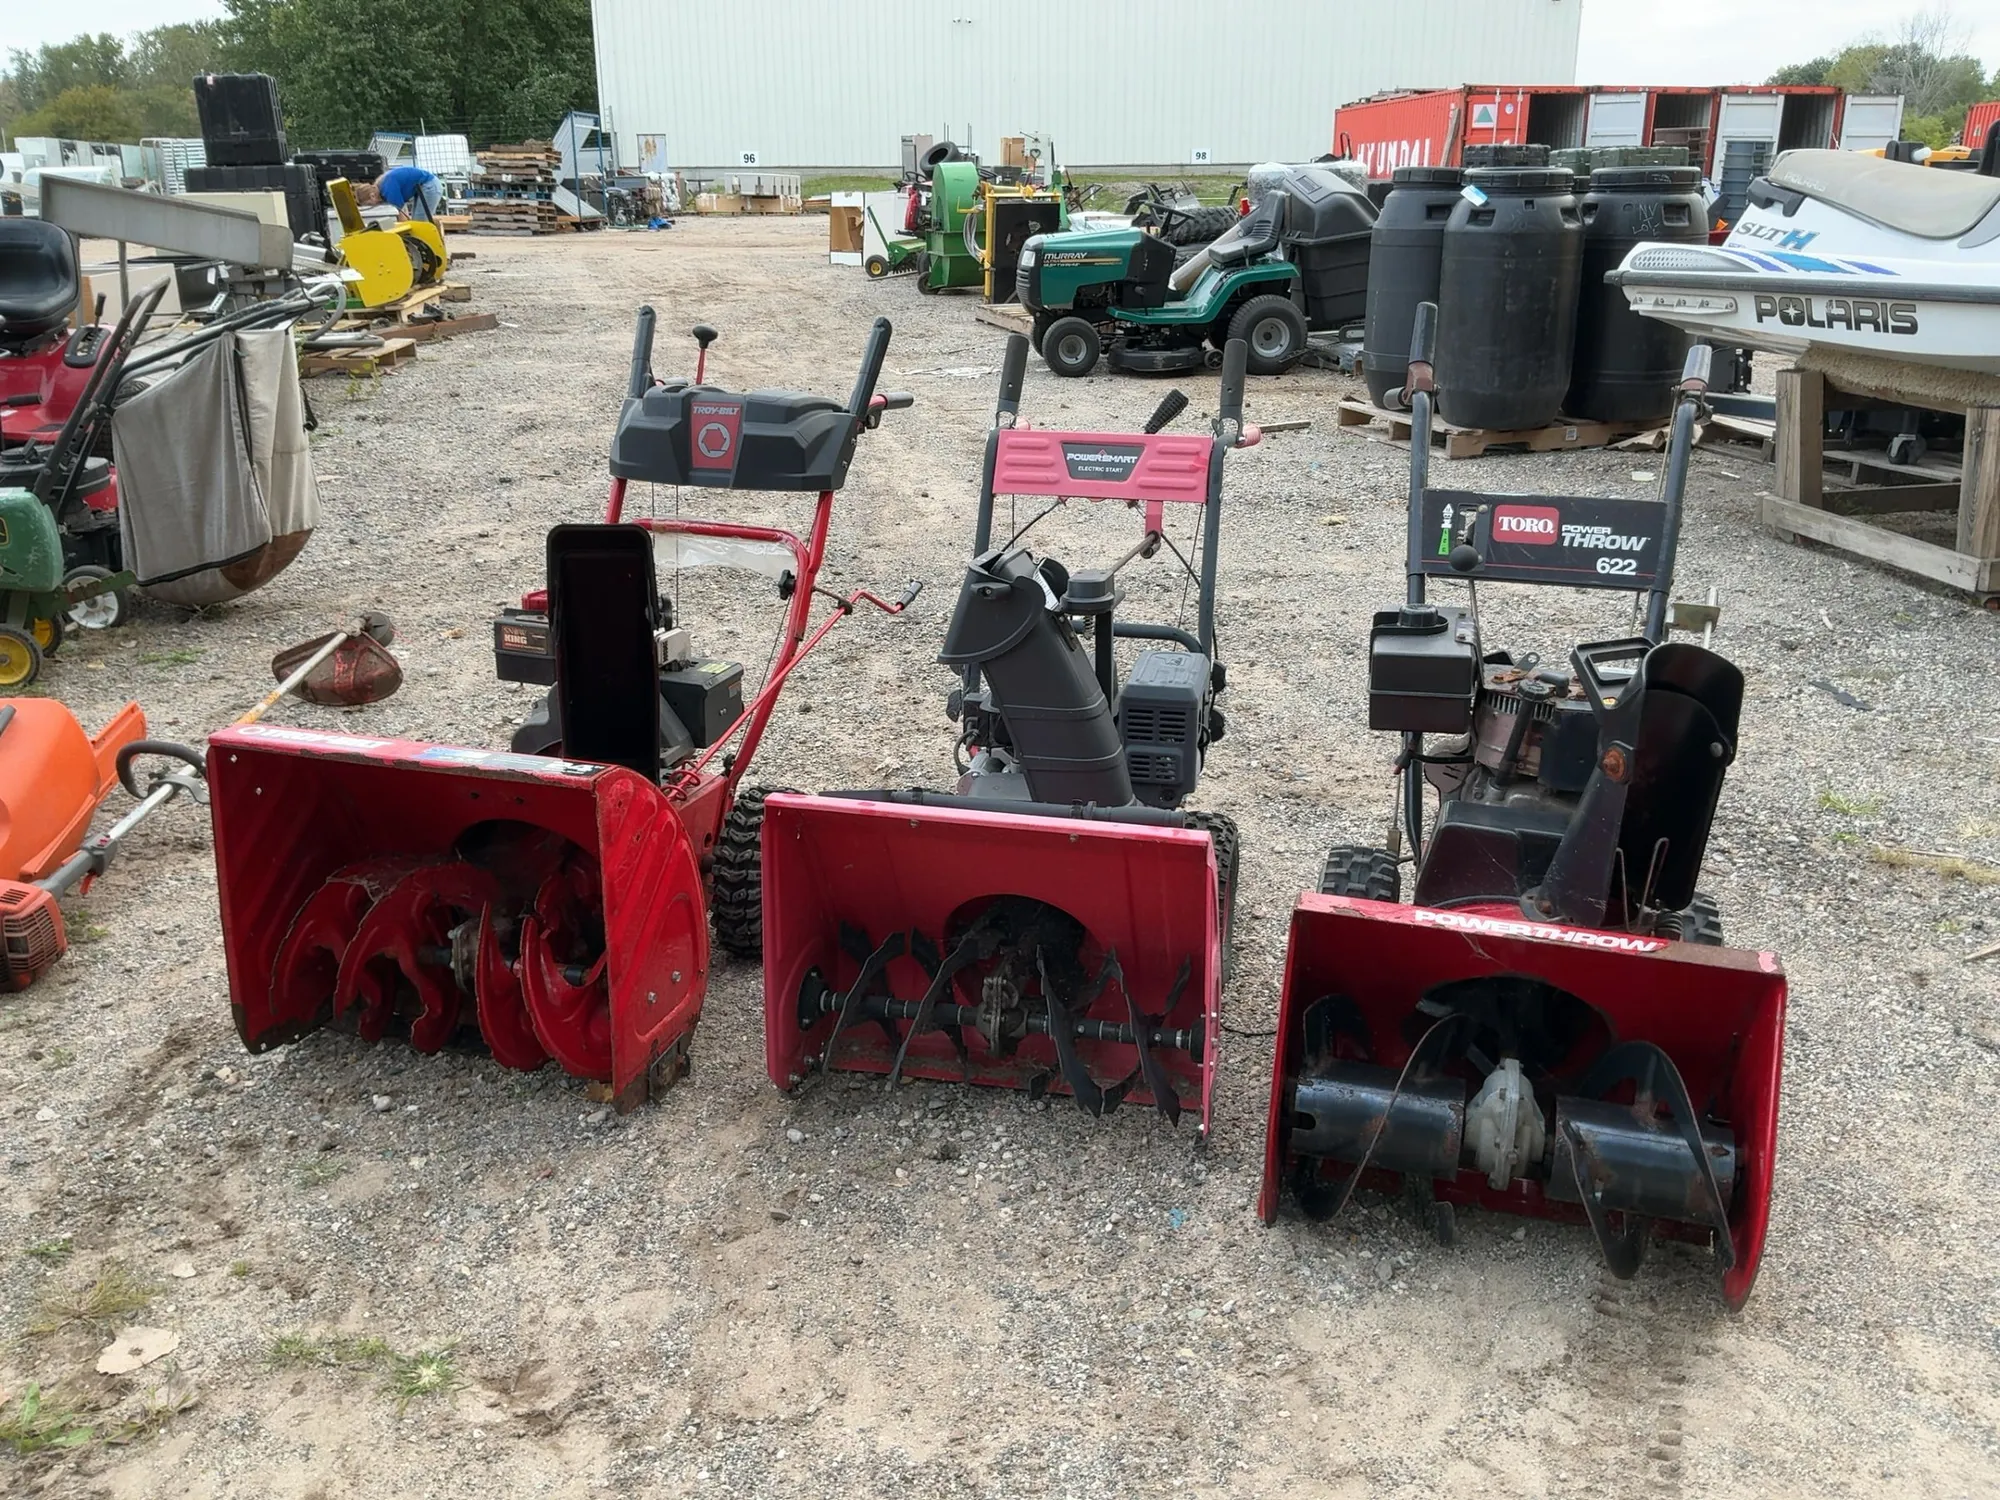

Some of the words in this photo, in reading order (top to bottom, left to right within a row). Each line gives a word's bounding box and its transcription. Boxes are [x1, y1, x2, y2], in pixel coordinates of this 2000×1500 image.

[743, 153, 755, 163] 96
[1196, 151, 1207, 160] 98
[1356, 138, 1431, 175] HYUNDAI
[1754, 295, 1918, 335] POLARIS
[692, 406, 740, 415] TROY-BILT
[1561, 524, 1612, 534] POWER
[1561, 533, 1647, 551] THROW
[1596, 557, 1637, 576] 622
[504, 634, 528, 645] KING
